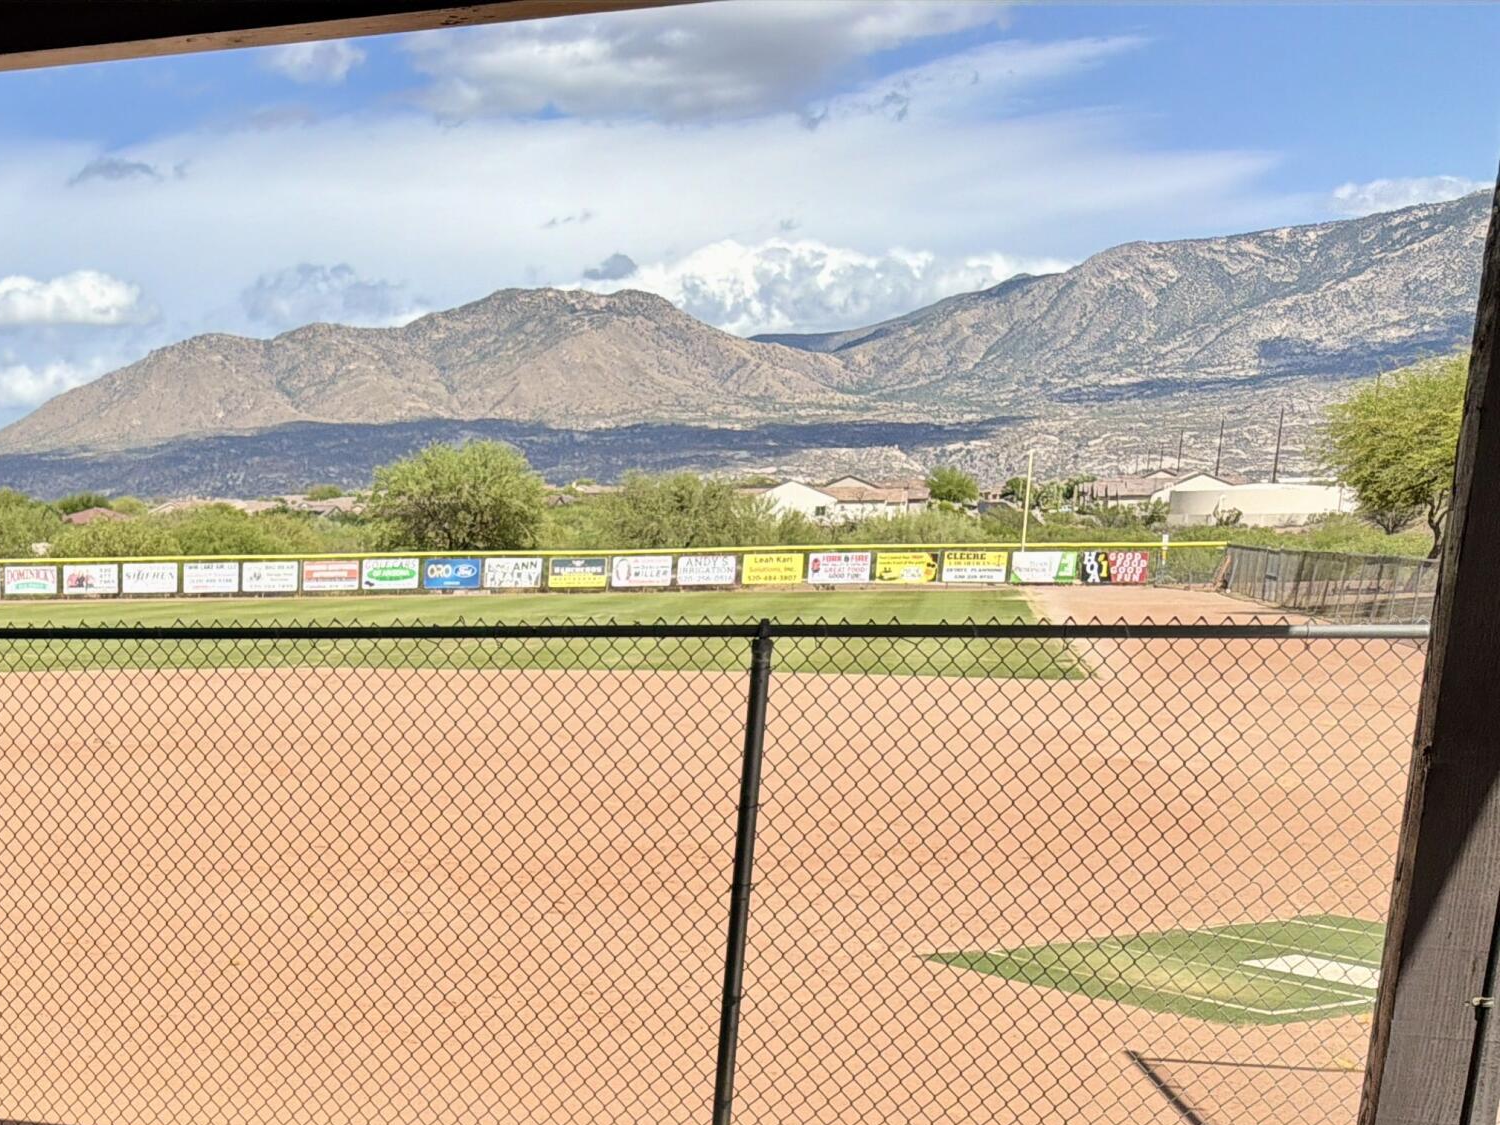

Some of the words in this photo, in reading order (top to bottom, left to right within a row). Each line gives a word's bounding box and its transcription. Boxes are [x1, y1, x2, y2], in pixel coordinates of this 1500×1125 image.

[1109, 552, 1141, 561] GOOD
[512, 561, 538, 571] ANN
[1116, 559, 1147, 567] FOOD
[427, 564, 452, 578] ORO
[1110, 567, 1143, 575] GOOD
[1116, 573, 1141, 582] FUN
